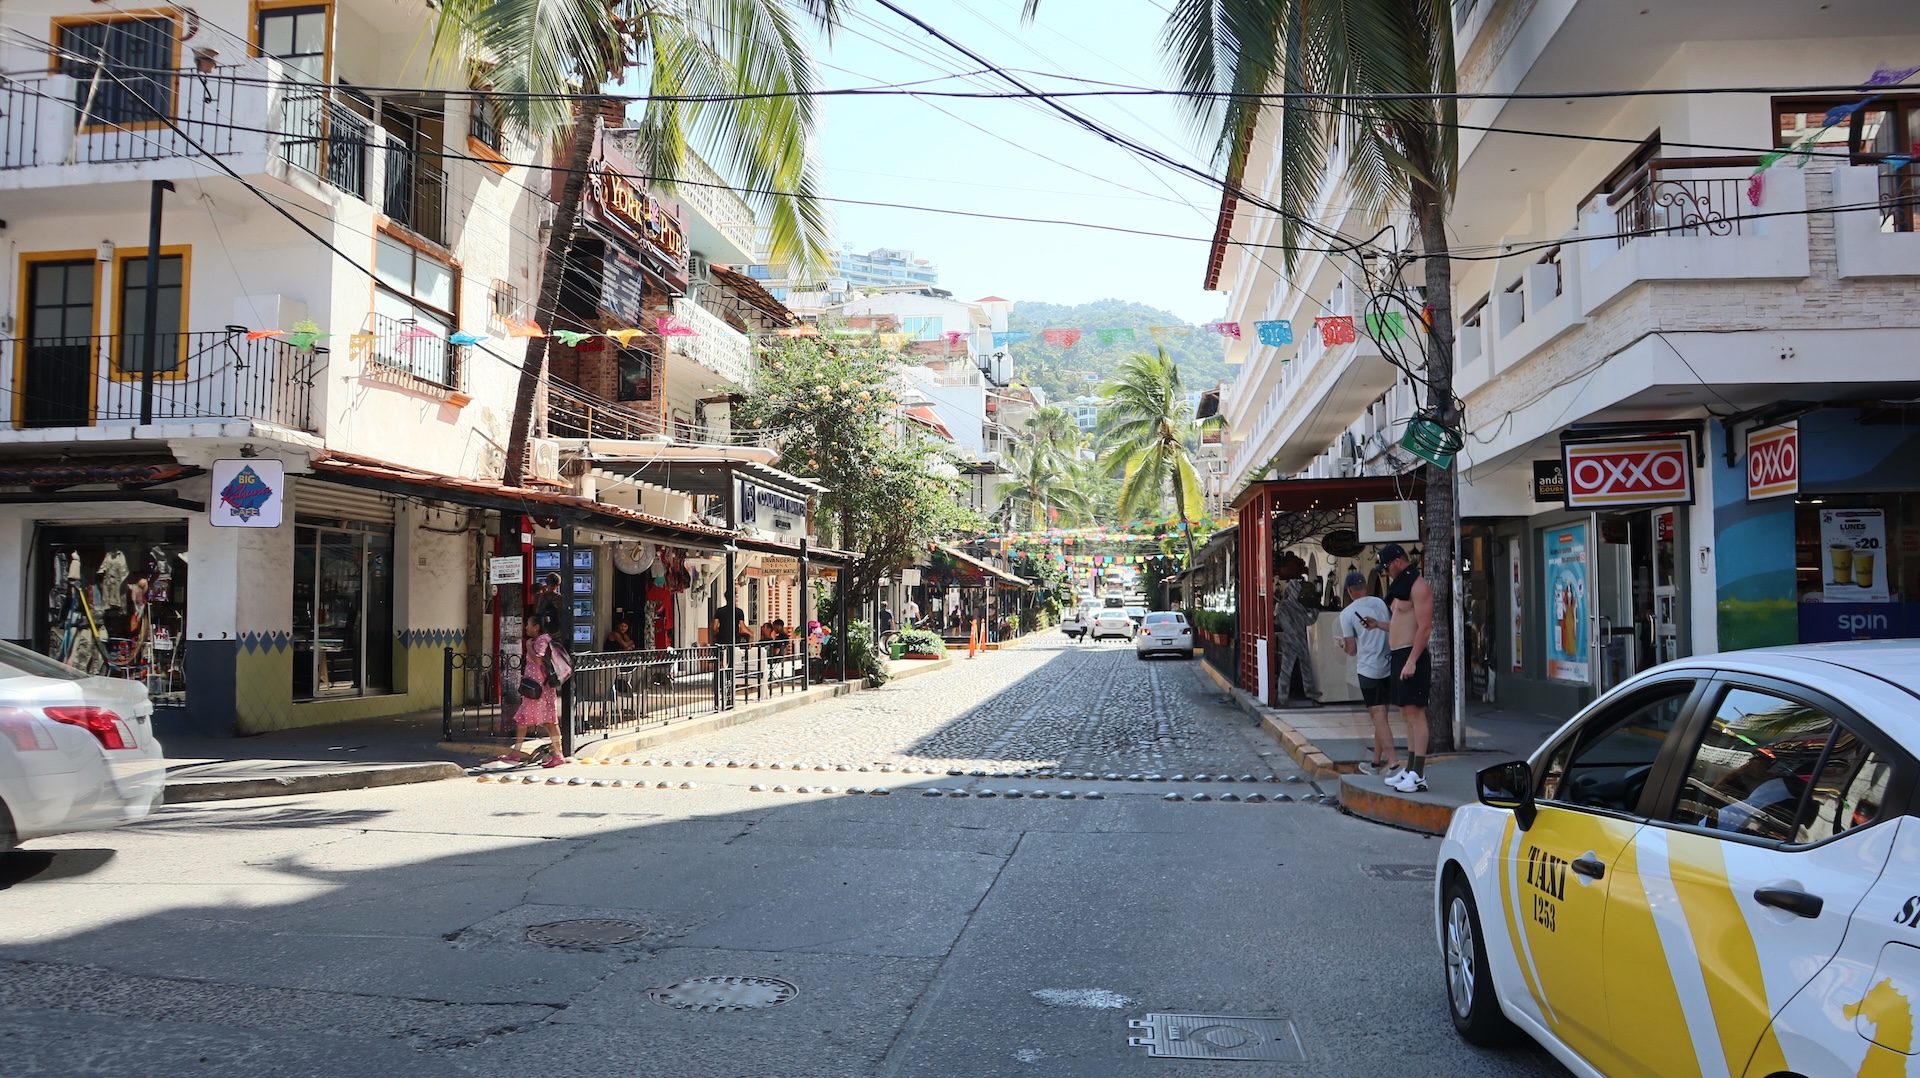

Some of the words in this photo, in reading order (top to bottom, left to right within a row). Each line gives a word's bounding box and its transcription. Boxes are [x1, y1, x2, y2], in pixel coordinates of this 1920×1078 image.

[609, 170, 643, 225] YORK
[660, 214, 682, 256] PUB
[1574, 453, 1682, 493] OXXO
[1751, 440, 1795, 485] OXXO
[238, 475, 255, 484] BIG
[220, 484, 273, 509] Kahuna
[757, 490, 785, 511] COLDWELL
[1376, 518, 1398, 526] OPAL
[1840, 523, 1866, 531] LUNES
[1838, 614, 1888, 634] spin
[1527, 845, 1568, 902] TAXI
[1533, 893, 1555, 933] 1253
